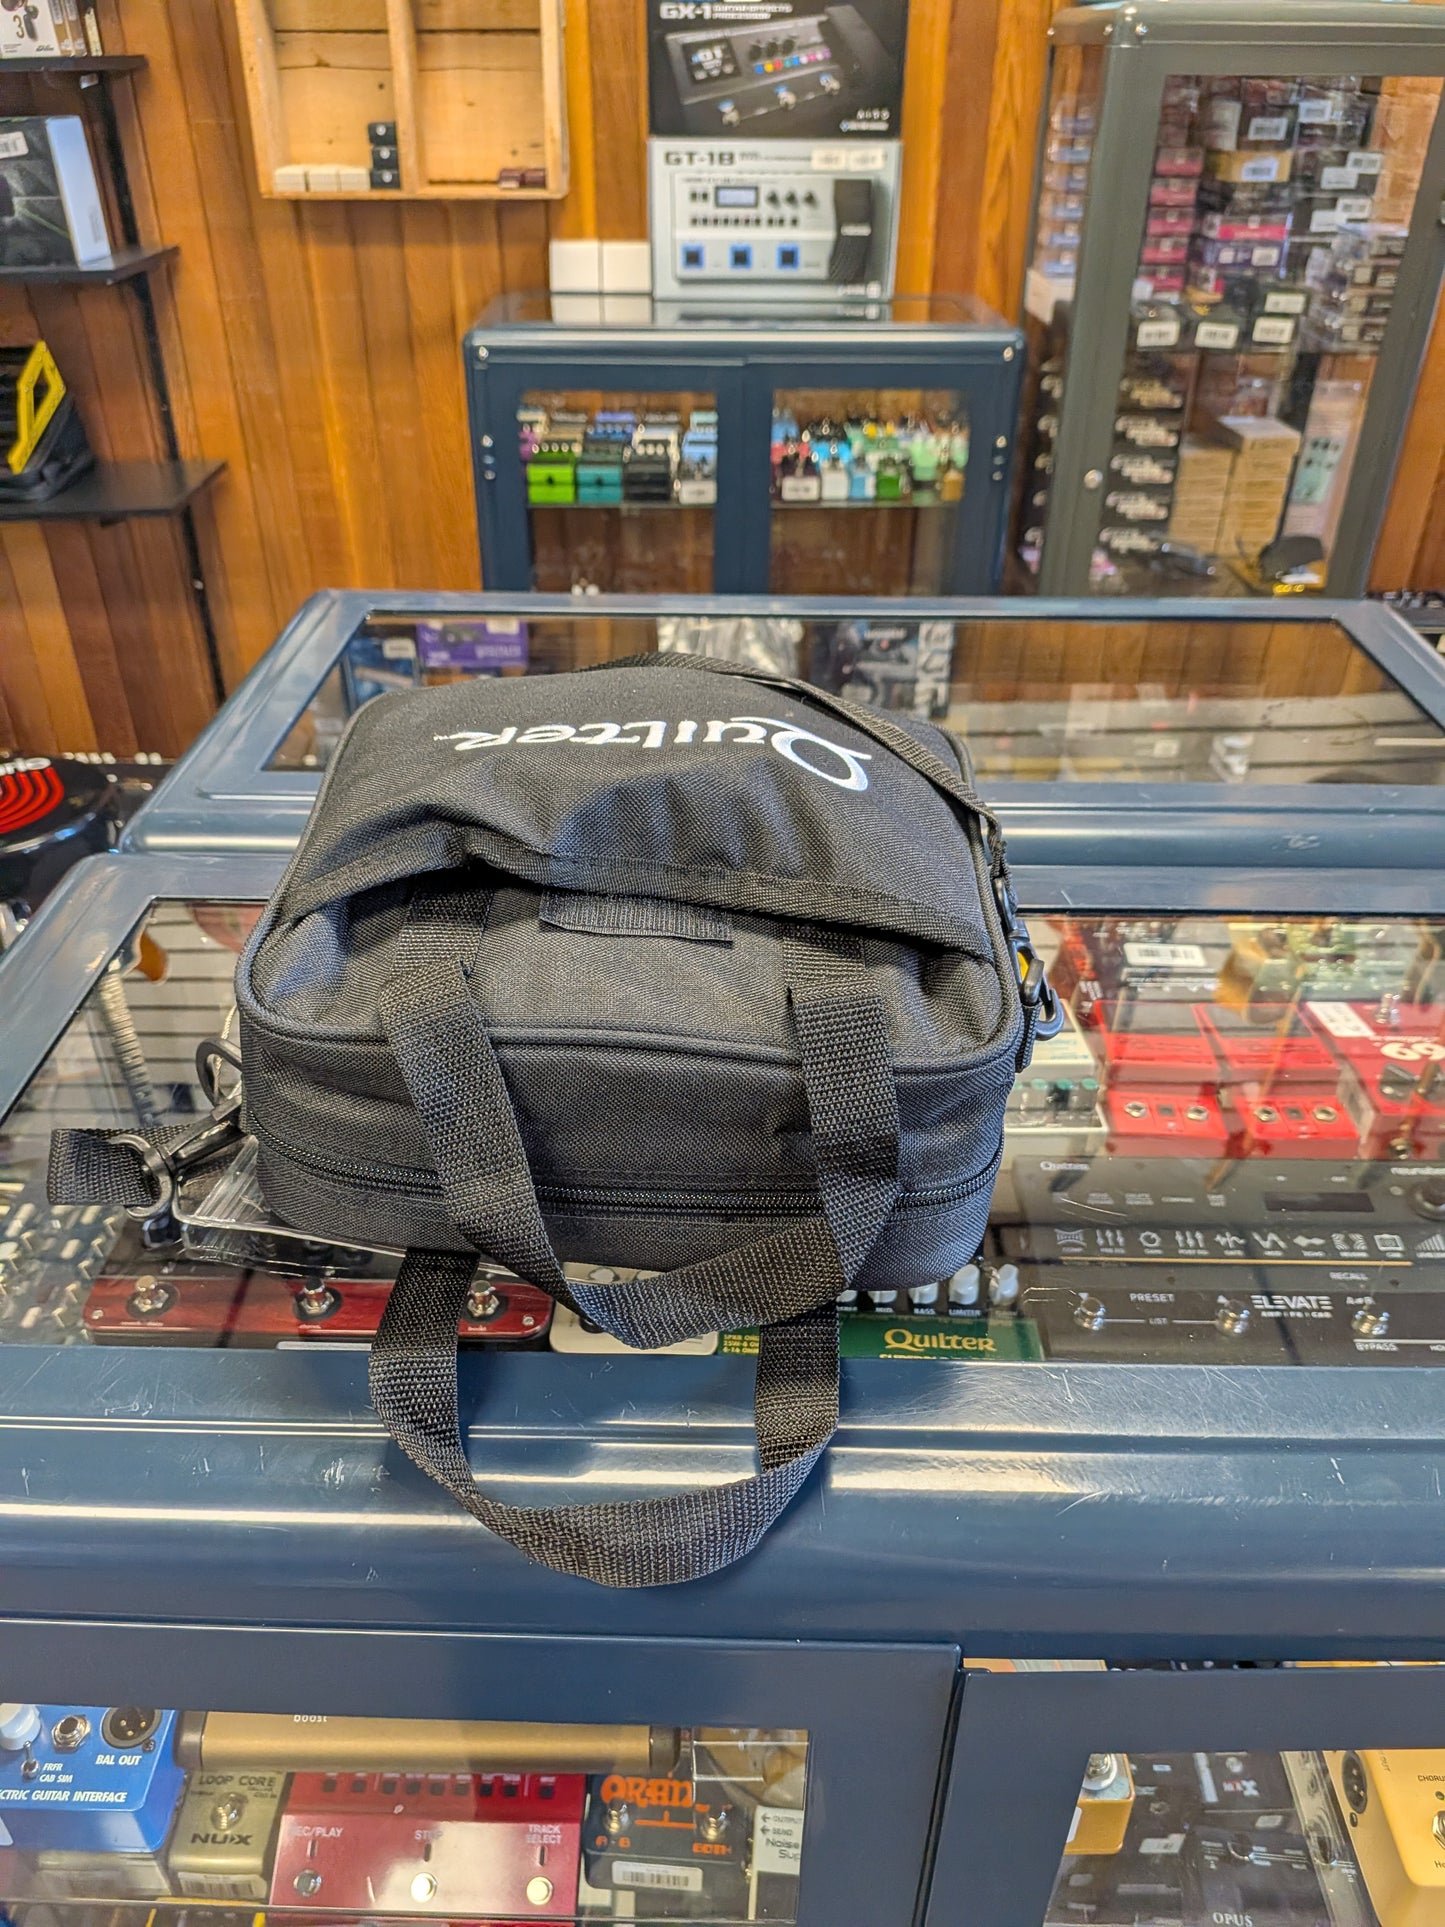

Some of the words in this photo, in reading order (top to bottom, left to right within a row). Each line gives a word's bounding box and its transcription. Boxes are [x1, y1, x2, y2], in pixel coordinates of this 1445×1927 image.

[659, 3, 712, 20] GX-1
[1129, 1293, 1175, 1303] PRESET
[1251, 1295, 1334, 1310] ELEVATE
[913, 1308, 936, 1316] BASS
[948, 1309, 982, 1318] LIMITER
[1355, 1342, 1399, 1351] BYPASS
[95, 1755, 115, 1765] BAL
[118, 1755, 142, 1766] OUT
[43, 1763, 63, 1771] FRFR
[39, 1774, 56, 1783] CAB
[57, 1775, 73, 1783] SIM
[199, 1775, 235, 1785] LOOP
[239, 1775, 277, 1787] CORE
[31, 1790, 70, 1801] GUITAR
[72, 1791, 128, 1803] INTERFACE
[528, 1825, 561, 1834] TRACK
[191, 1833, 253, 1845] NUX
[414, 1830, 443, 1841] STOP
[527, 1834, 562, 1844] SELECT
[765, 1838, 800, 1849] Noise
[1213, 1911, 1253, 1927] OPUS
